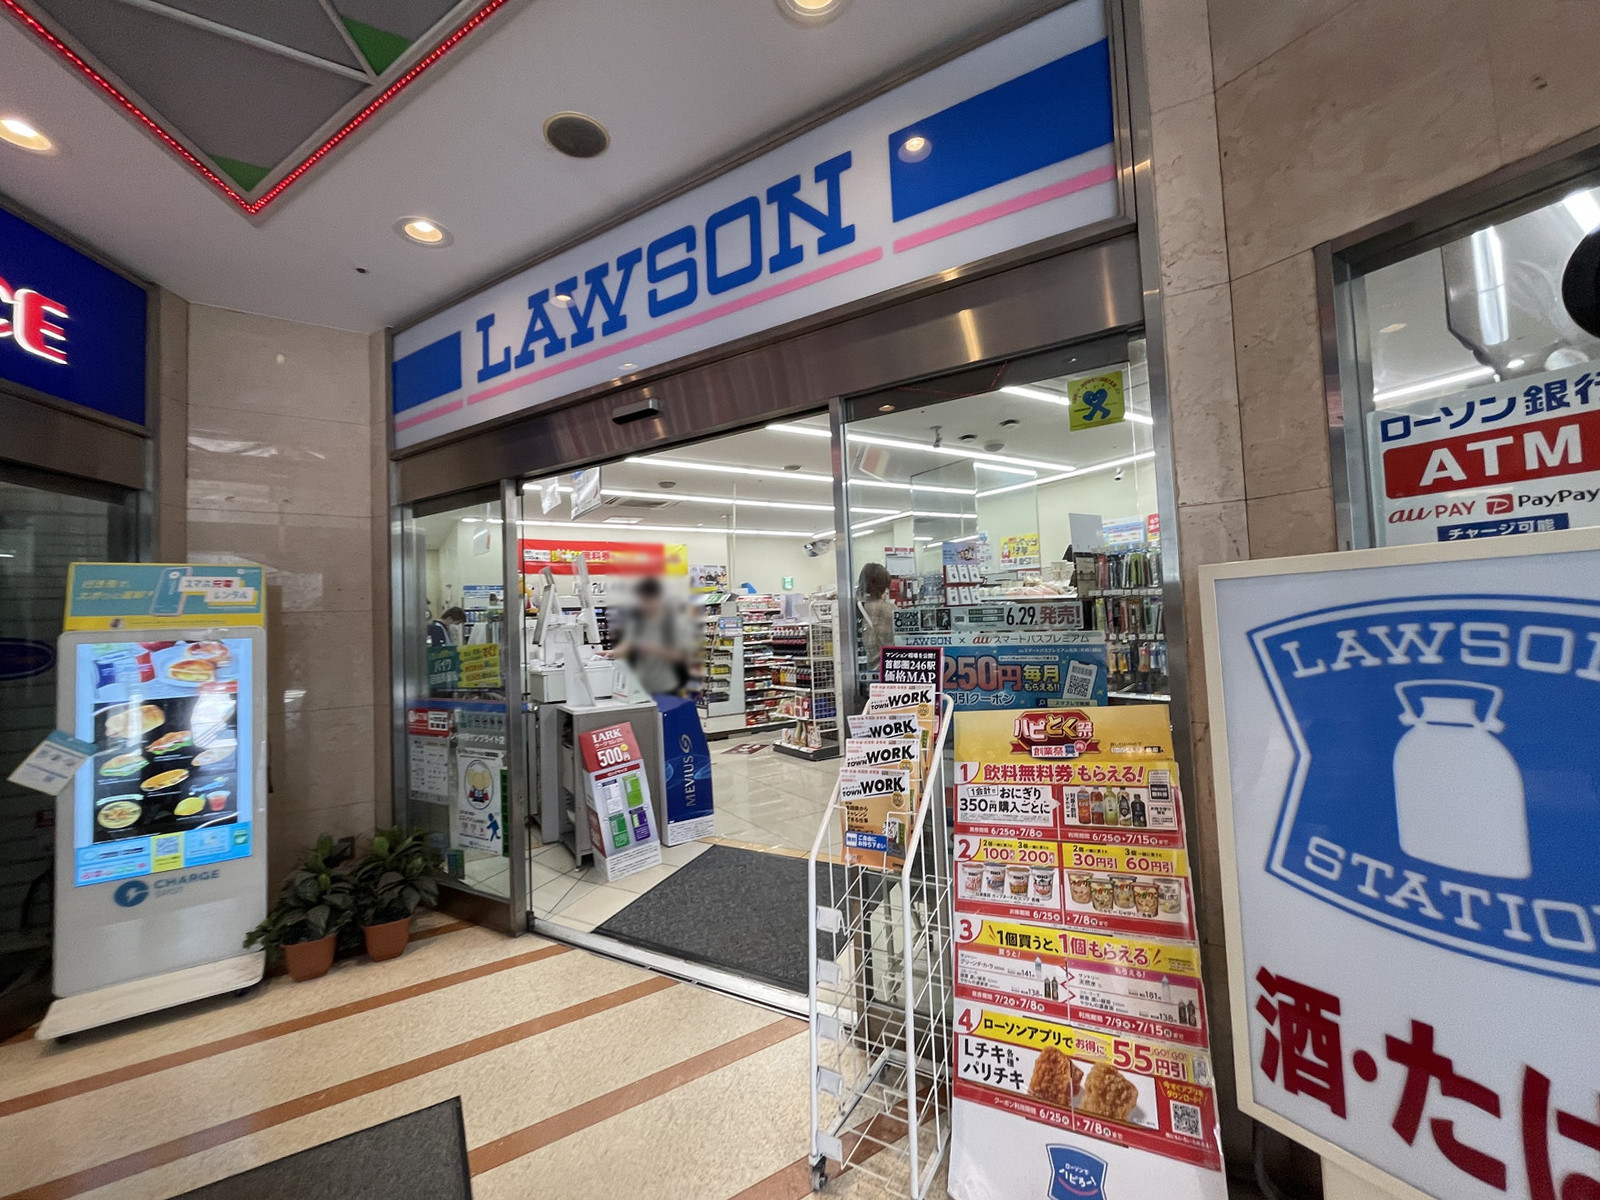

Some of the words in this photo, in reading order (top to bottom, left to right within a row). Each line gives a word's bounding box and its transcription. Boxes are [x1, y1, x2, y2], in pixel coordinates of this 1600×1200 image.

[476, 151, 857, 384] LAWSON
[0, 275, 69, 366] E
[1419, 424, 1583, 487] ATM
[1388, 506, 1433, 524] au
[1435, 500, 1476, 518] PAY
[1518, 489, 1600, 508] PayPay
[1448, 518, 1556, 540] チャージ可能
[1006, 606, 1036, 626] 6.29
[1040, 605, 1081, 625] 発売!
[905, 636, 953, 646] LAWSON
[885, 659, 936, 670] 首都圏246駅
[943, 655, 1022, 692] 250円
[1023, 664, 1060, 683] 毎月
[884, 670, 936, 683] 価格MAP
[871, 702, 888, 710] TOWN
[888, 689, 932, 707] WORK
[592, 728, 623, 744] LARK
[869, 719, 917, 738] WORK
[1013, 713, 1095, 740] ハピとく祭
[847, 760, 867, 768] TOWN
[866, 745, 915, 764] WORK
[682, 754, 696, 808] MEVIUS
[960, 763, 968, 781] 1
[984, 764, 1073, 783] 飲料無料券
[1077, 765, 1145, 783] もらえる!
[842, 789, 862, 797] TOWN
[860, 776, 906, 794] WORK
[1000, 786, 1041, 800] おにぎり
[999, 800, 1051, 814] 購入ごとに
[957, 839, 971, 859] 2
[1073, 853, 1118, 869] 30円引
[1126, 857, 1174, 873] 60円引
[153, 869, 221, 890] CHARGE
[1304, 835, 1600, 953] STATIO
[959, 918, 973, 941] 3
[997, 930, 1059, 953] 1個買うと、
[958, 1009, 973, 1030] 4
[984, 1018, 1074, 1049] ローソンアプリで
[1075, 1038, 1107, 1056] お得に
[963, 1061, 1025, 1090] パリチキ
